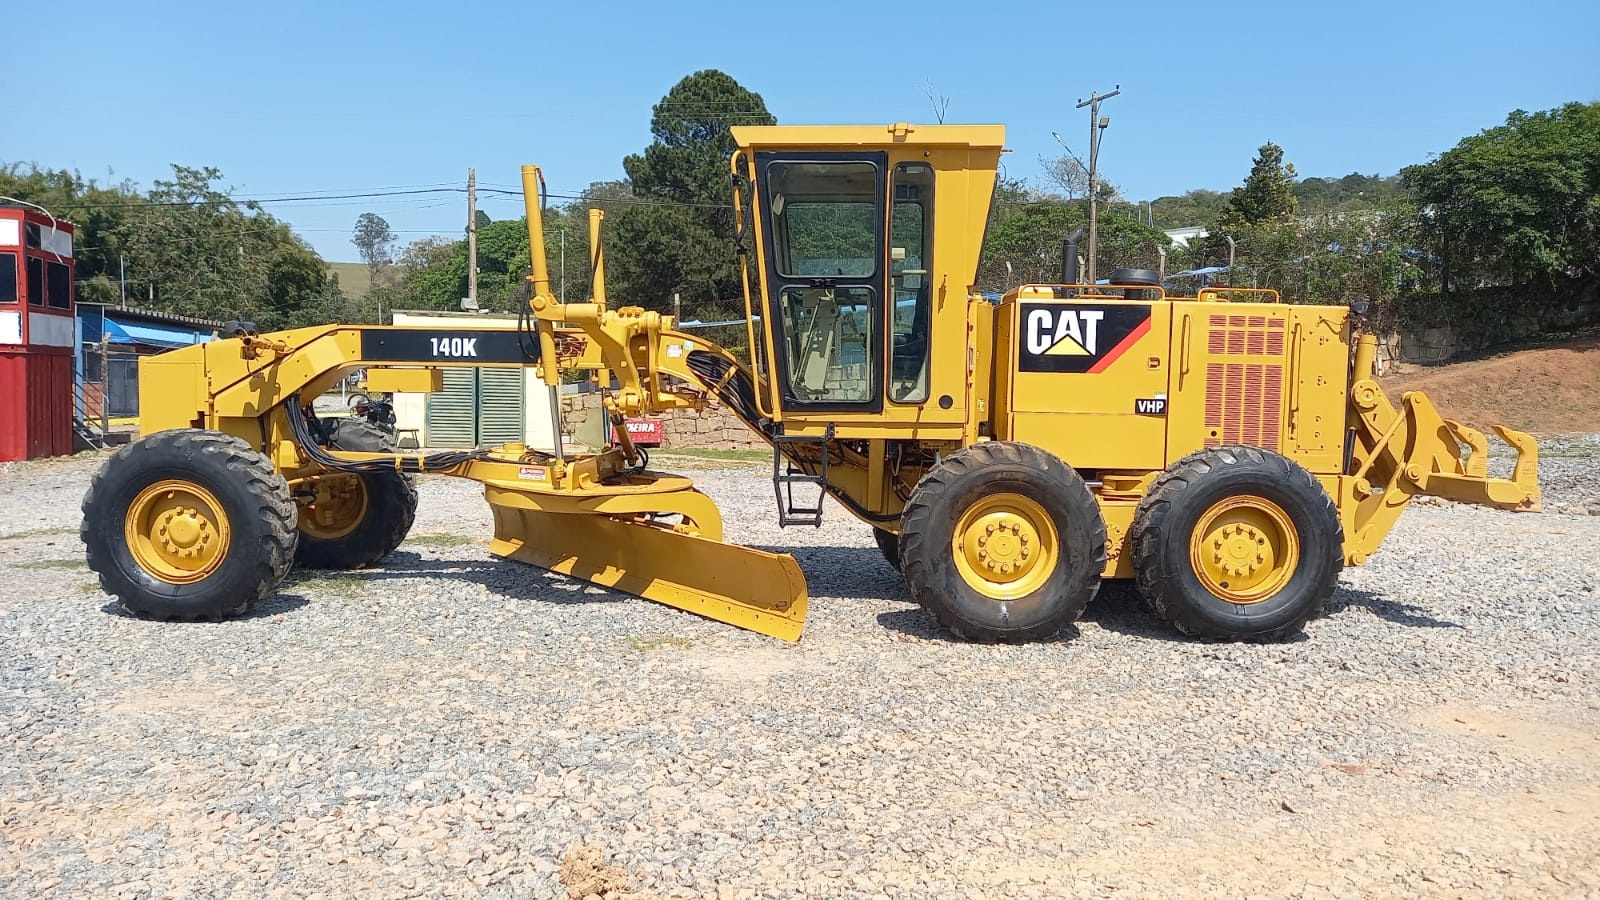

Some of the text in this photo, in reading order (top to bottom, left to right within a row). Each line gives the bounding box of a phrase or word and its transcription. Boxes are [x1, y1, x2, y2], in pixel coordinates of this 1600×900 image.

[1027, 309, 1104, 356] CAT
[430, 337, 477, 357] 140K
[1137, 400, 1164, 413] VHP
